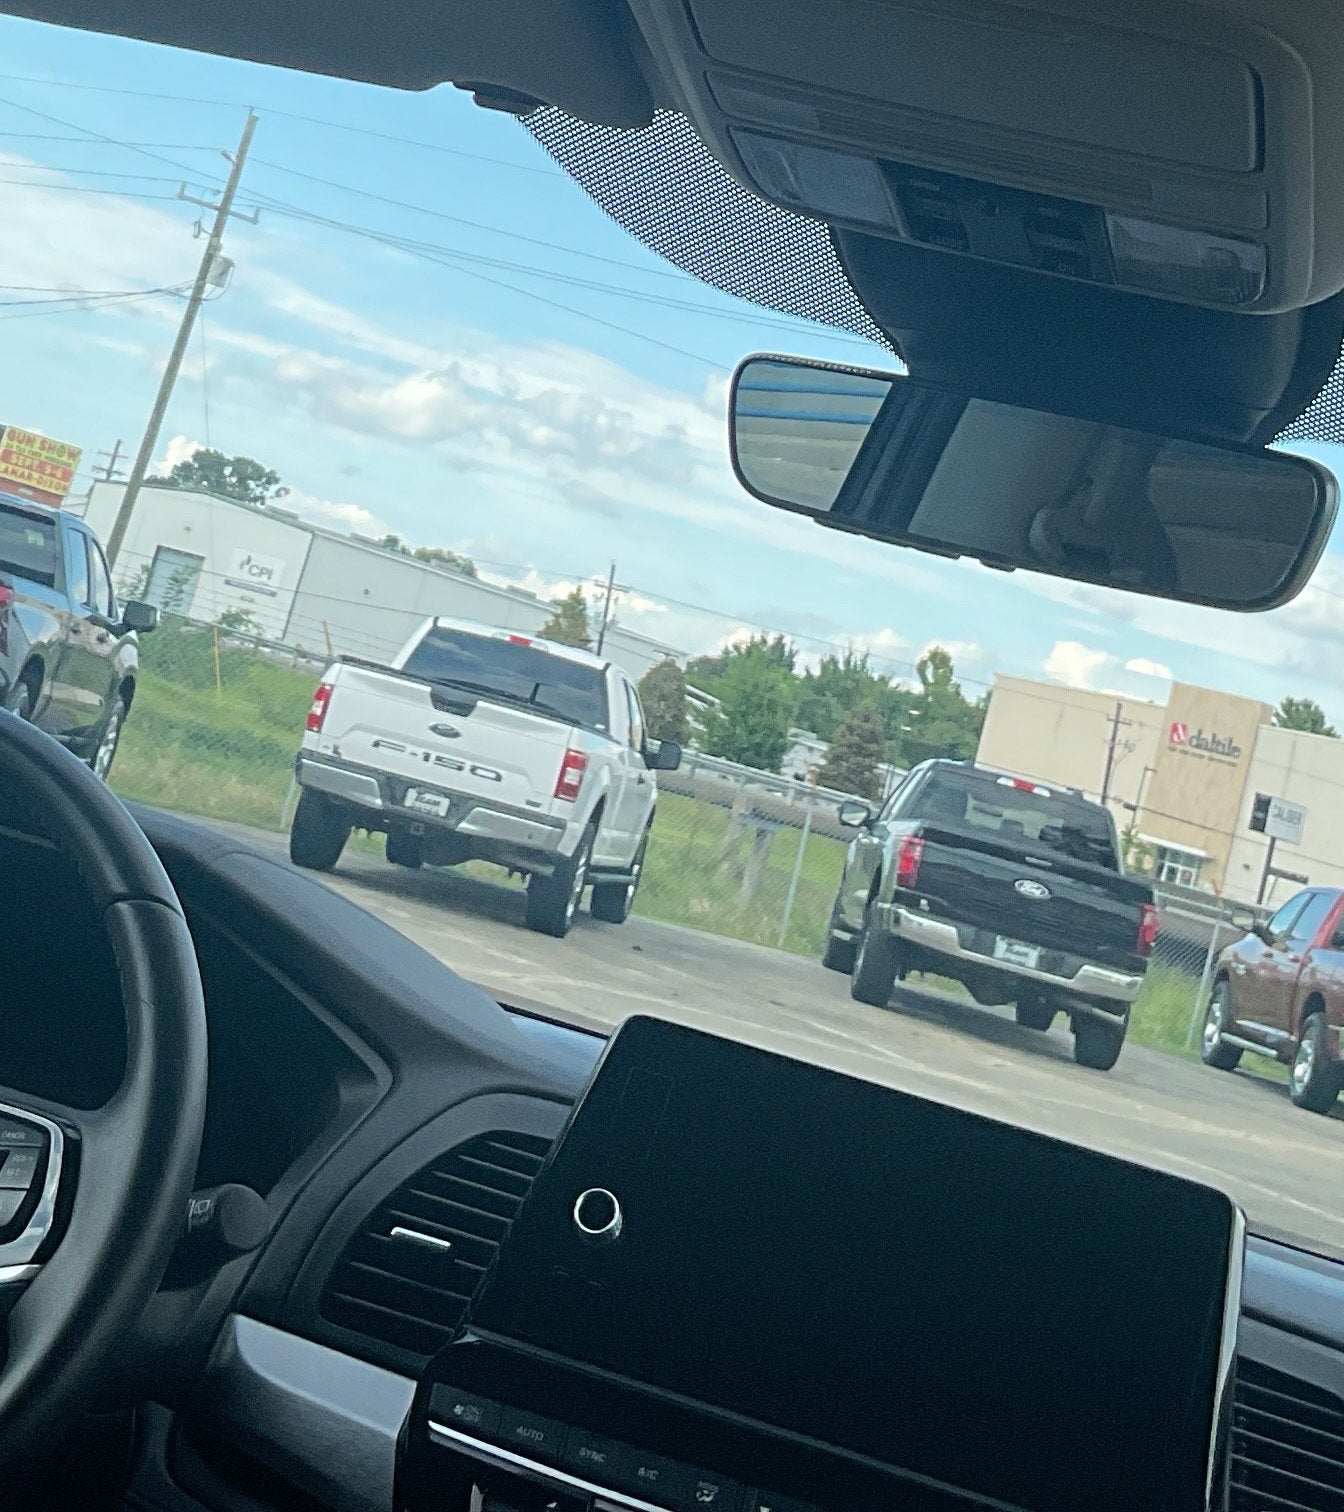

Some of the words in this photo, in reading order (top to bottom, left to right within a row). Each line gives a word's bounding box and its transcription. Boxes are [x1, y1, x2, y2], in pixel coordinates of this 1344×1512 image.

[38, 438, 79, 461] SHOW
[9, 453, 39, 471] SEPT
[248, 564, 274, 580] CPI
[372, 740, 502, 782] F-150
[516, 1426, 544, 1441] AUTO
